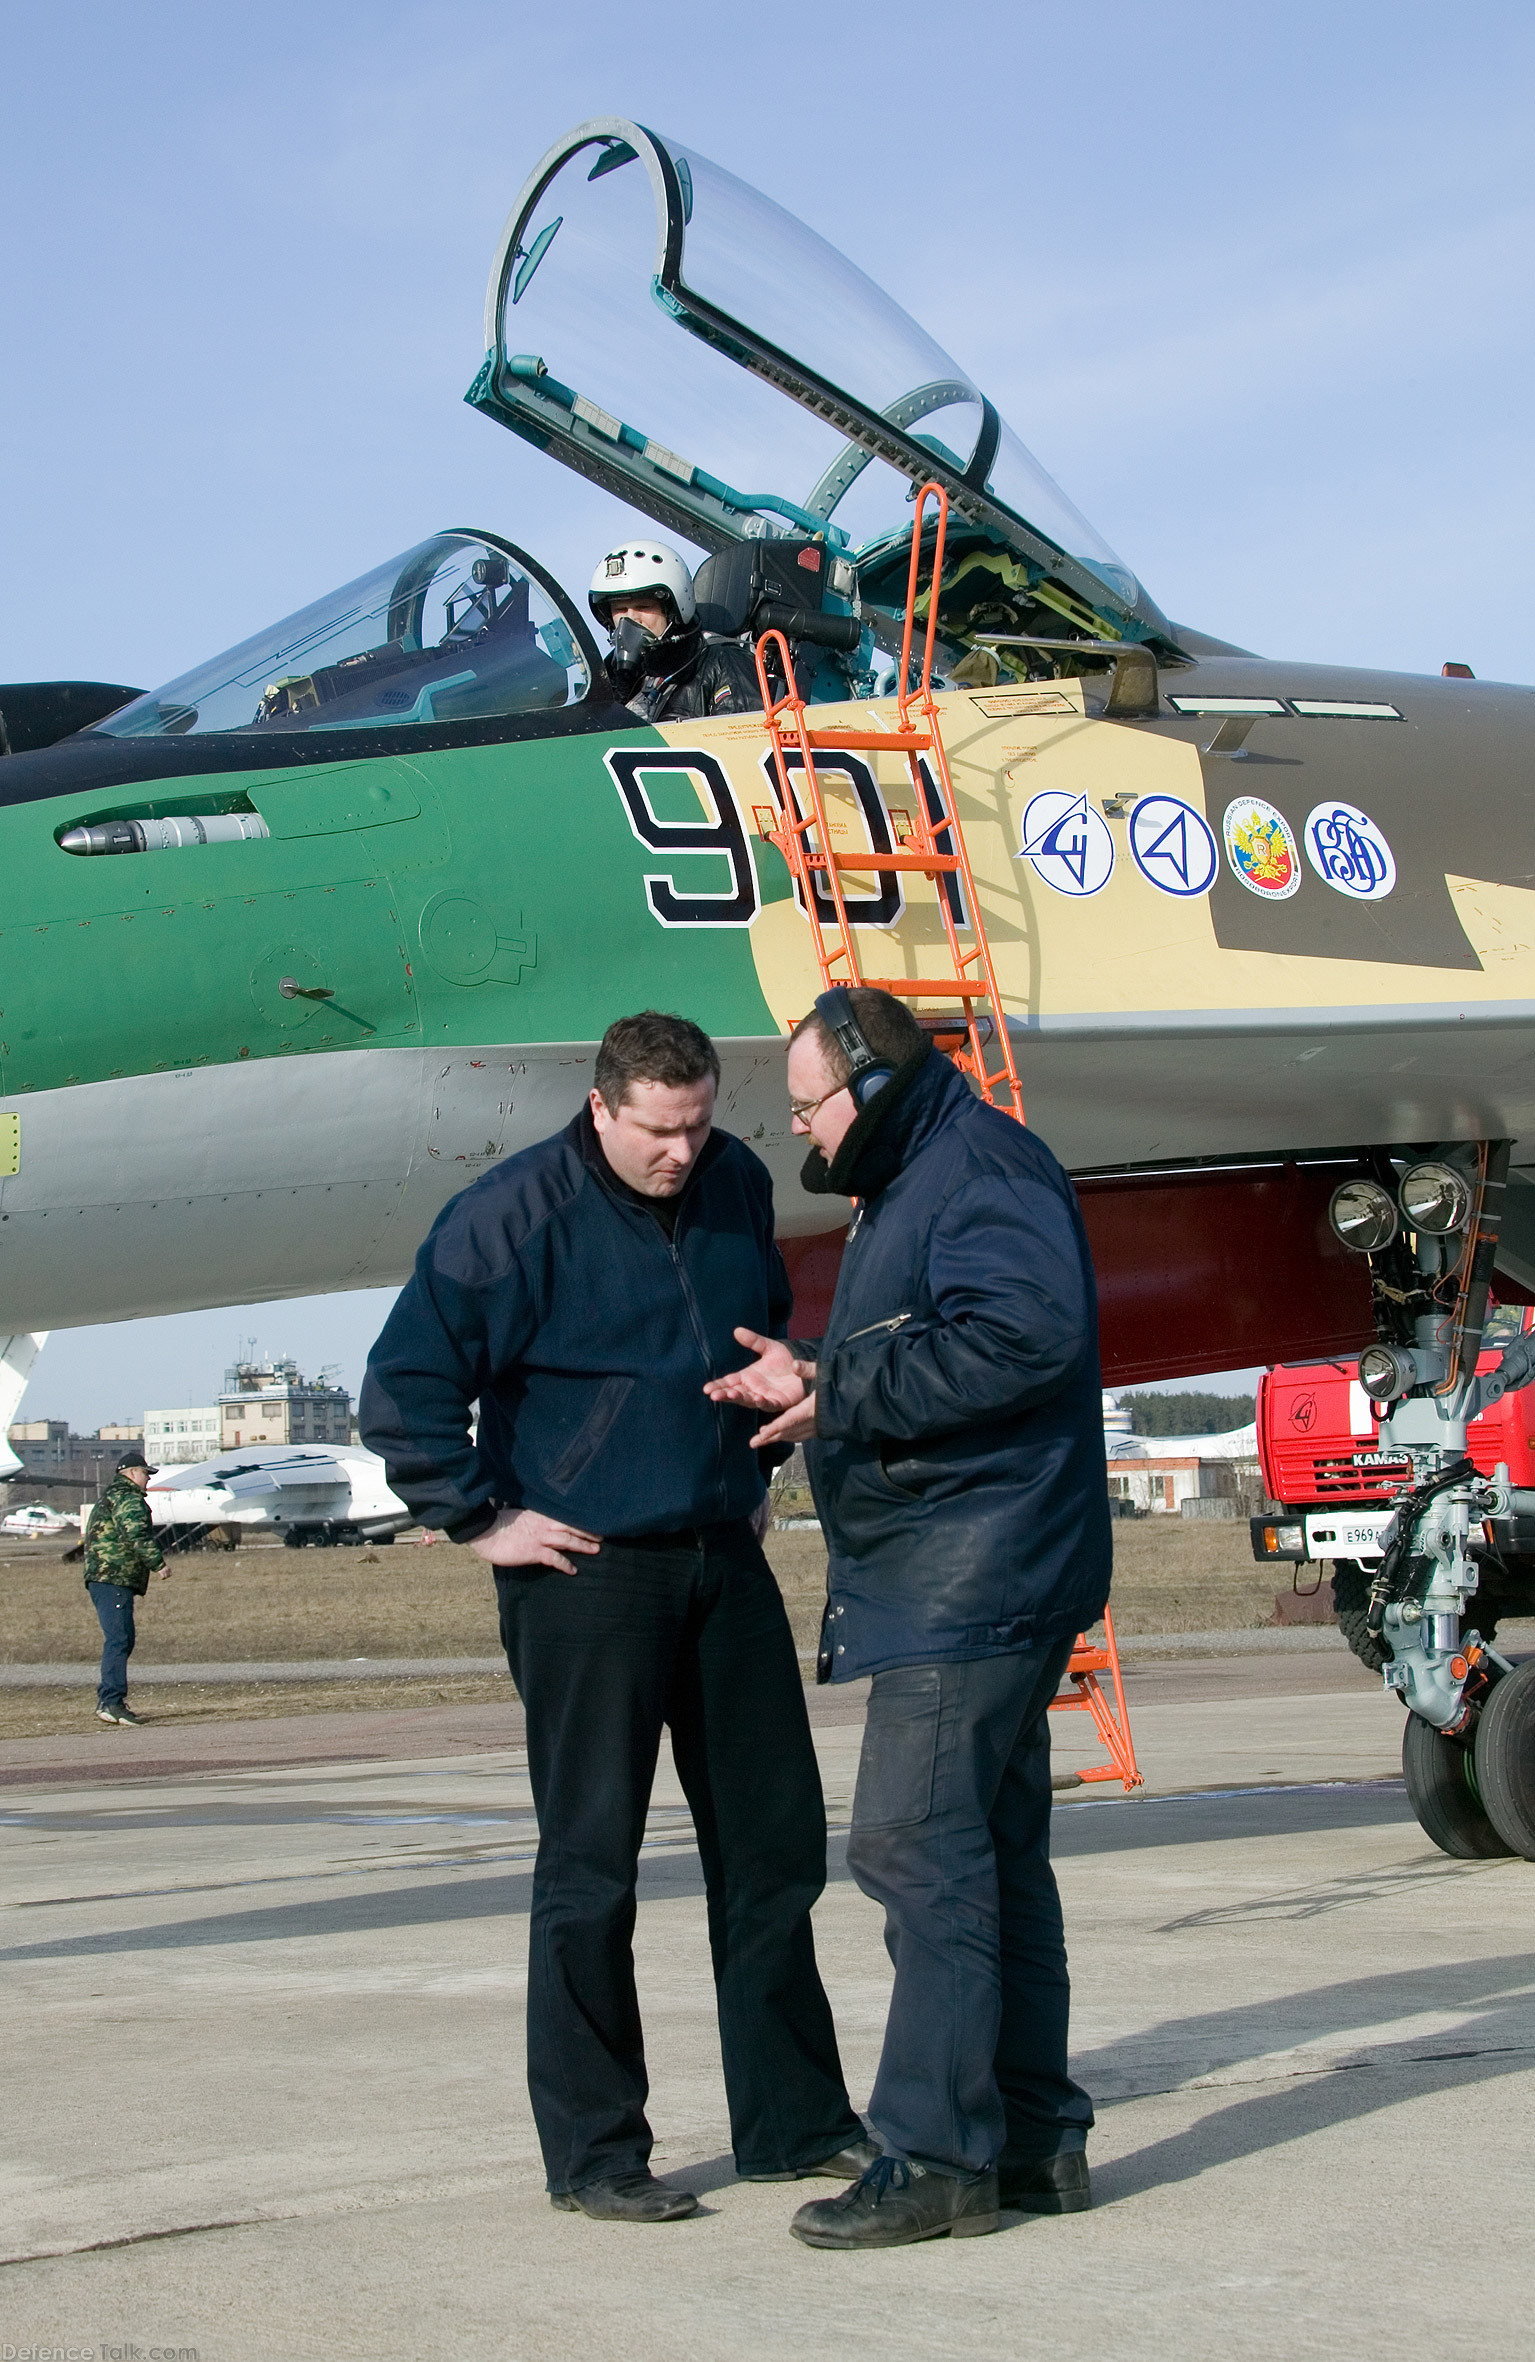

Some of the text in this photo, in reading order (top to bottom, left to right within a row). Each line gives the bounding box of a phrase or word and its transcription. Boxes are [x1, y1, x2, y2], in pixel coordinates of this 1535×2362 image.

[603, 747, 972, 930] 901
[1226, 799, 1293, 843] RUSSIAN DEFENCE EXPORT
[1257, 844, 1266, 855] R
[1235, 867, 1299, 897] ROSOBORONEXPORT
